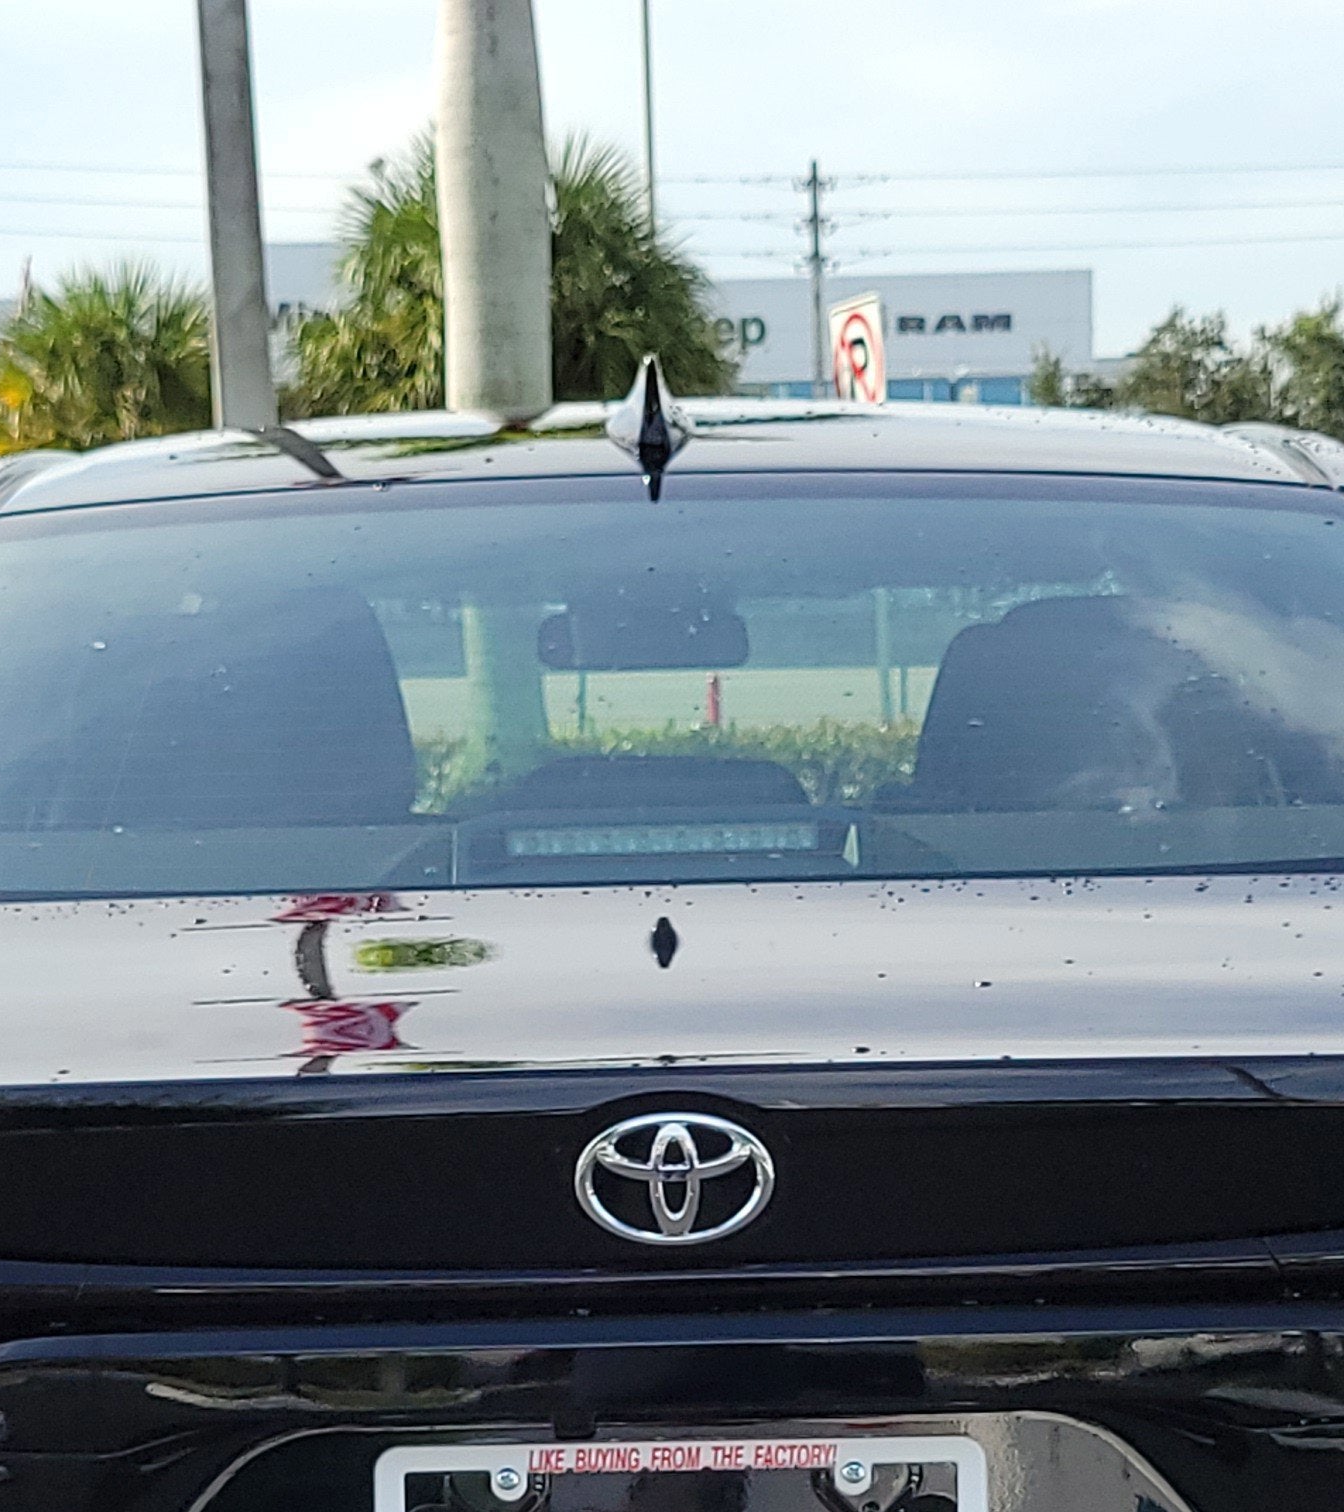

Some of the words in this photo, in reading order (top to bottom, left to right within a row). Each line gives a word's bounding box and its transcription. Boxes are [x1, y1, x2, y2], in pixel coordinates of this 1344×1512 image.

[898, 314, 1012, 333] RAM
[528, 1448, 565, 1473] LIKE
[575, 1448, 640, 1472] BUYING
[651, 1446, 701, 1470] FROM
[711, 1445, 744, 1468] THE
[753, 1443, 838, 1468] FACTORY!
